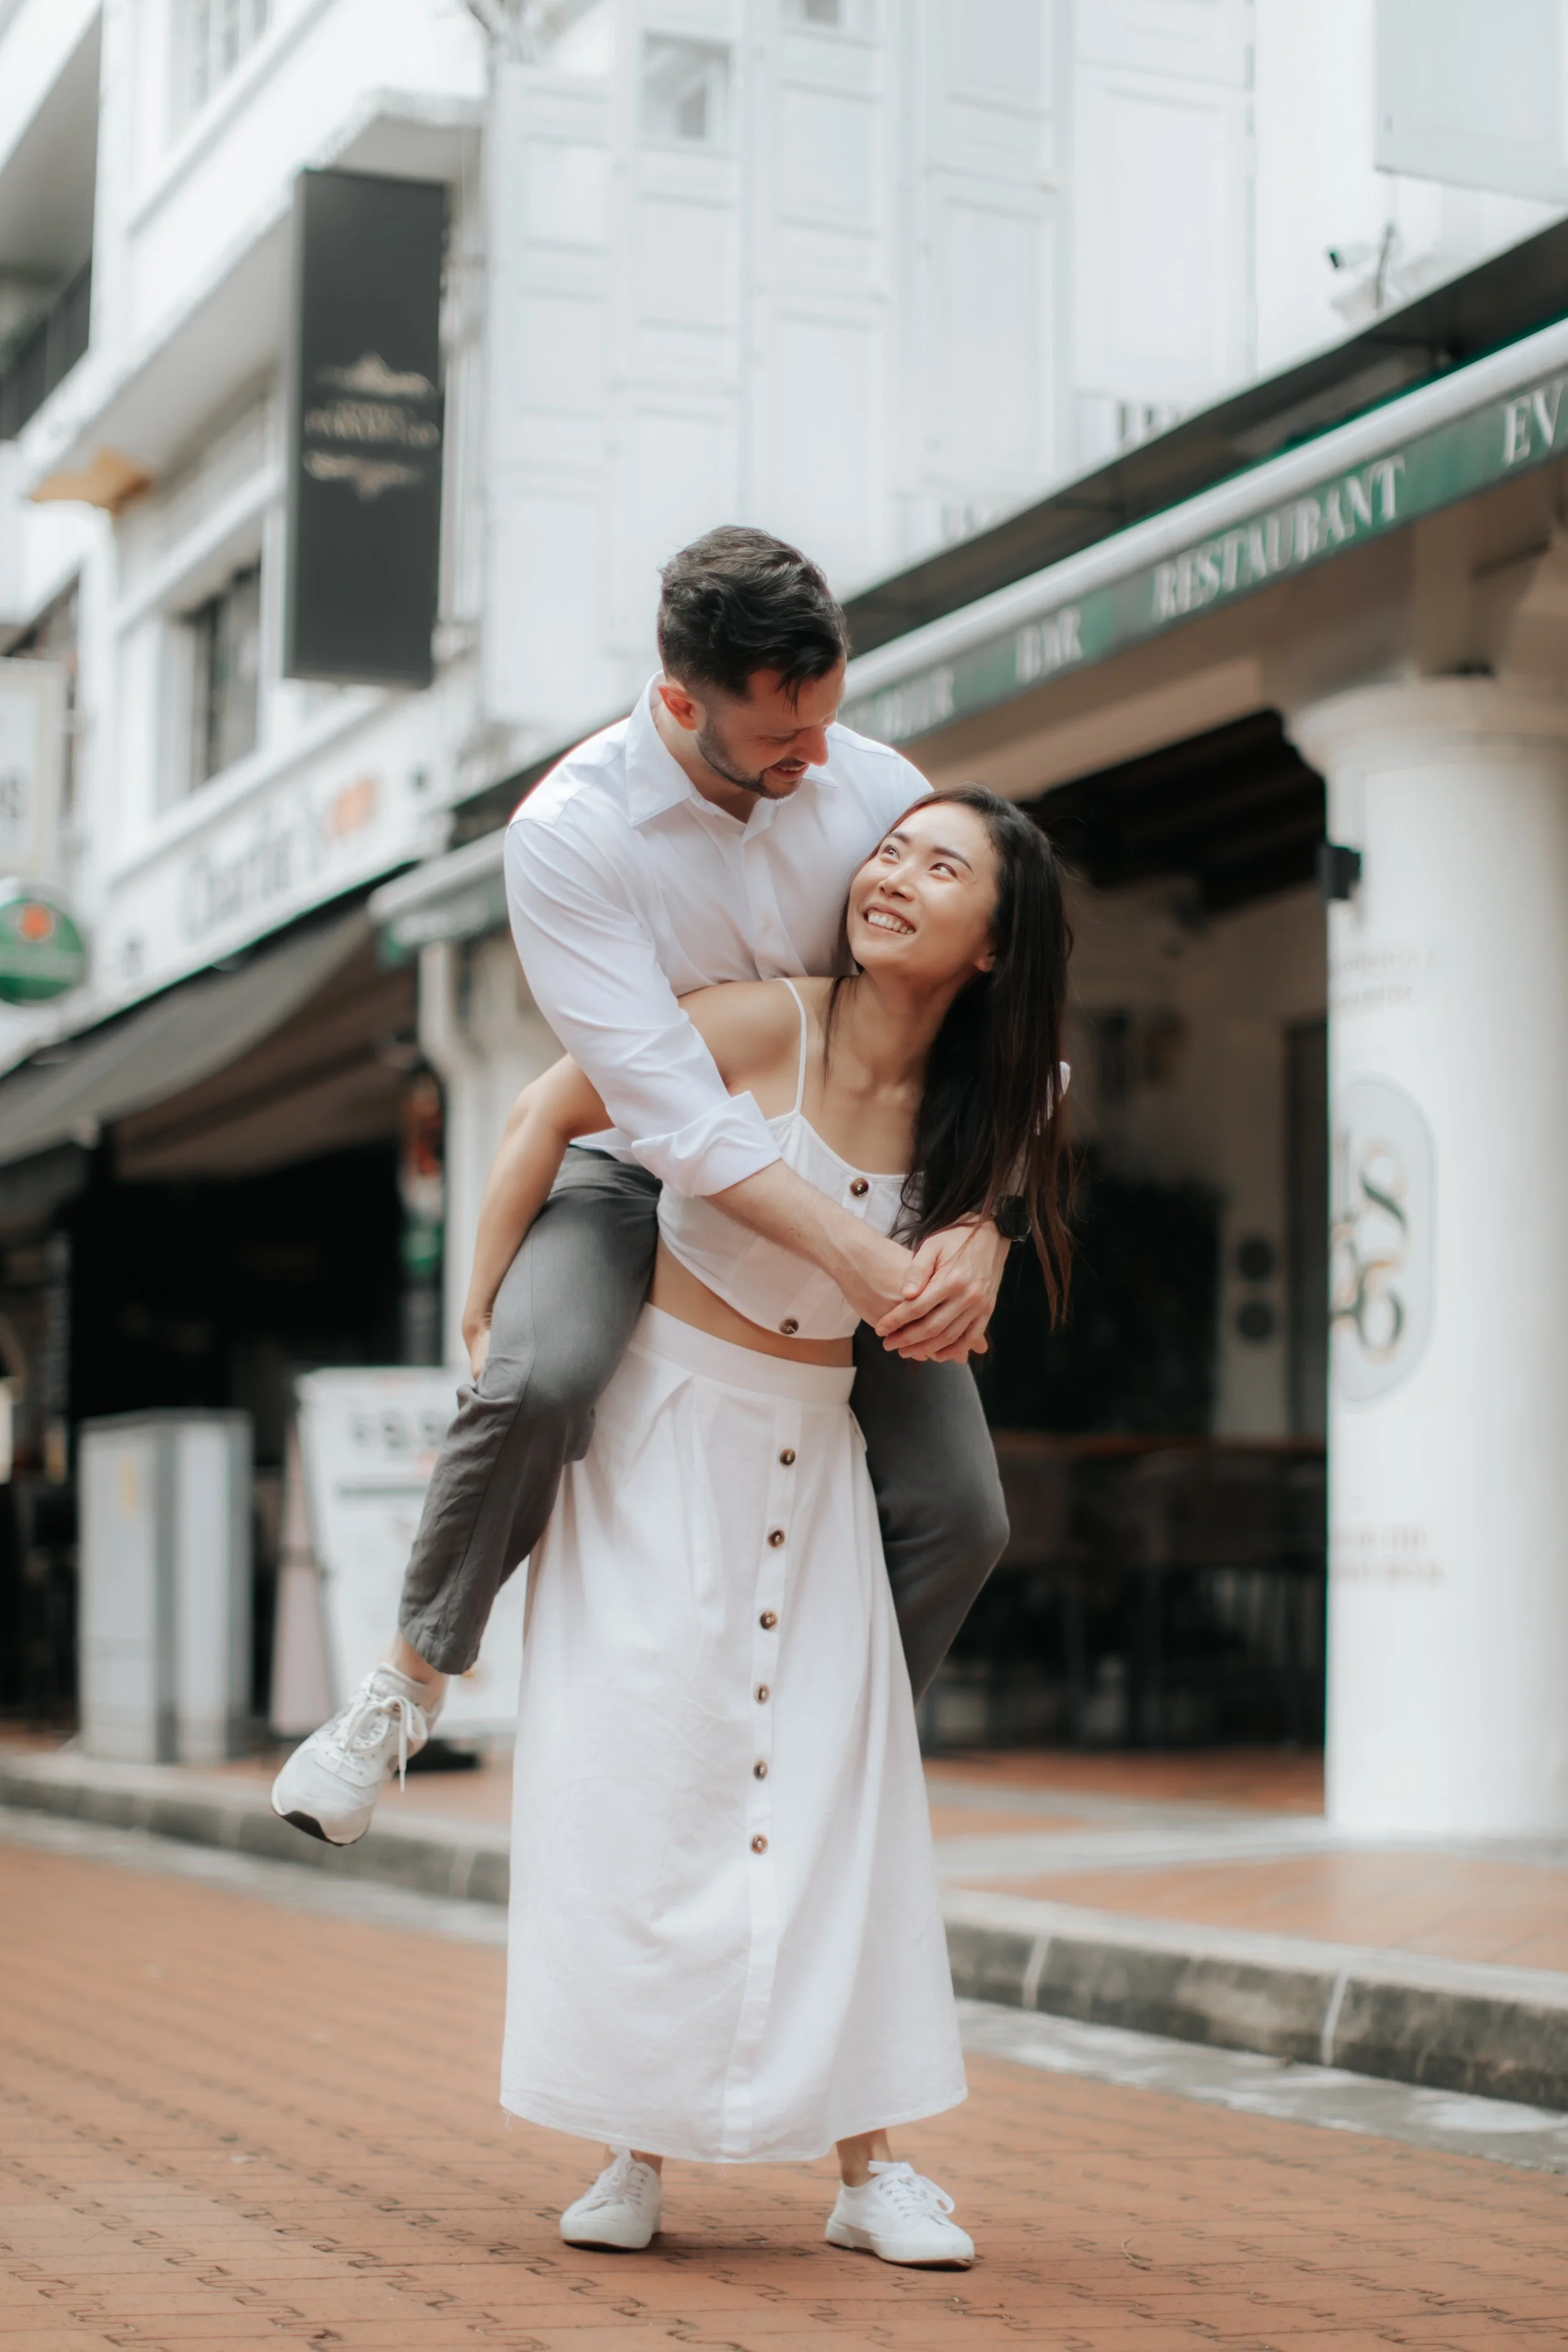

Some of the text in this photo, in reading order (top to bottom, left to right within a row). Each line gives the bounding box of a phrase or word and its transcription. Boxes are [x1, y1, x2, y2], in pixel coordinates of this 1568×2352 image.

[1015, 377, 1568, 684] BAR RESTAURANT EV
